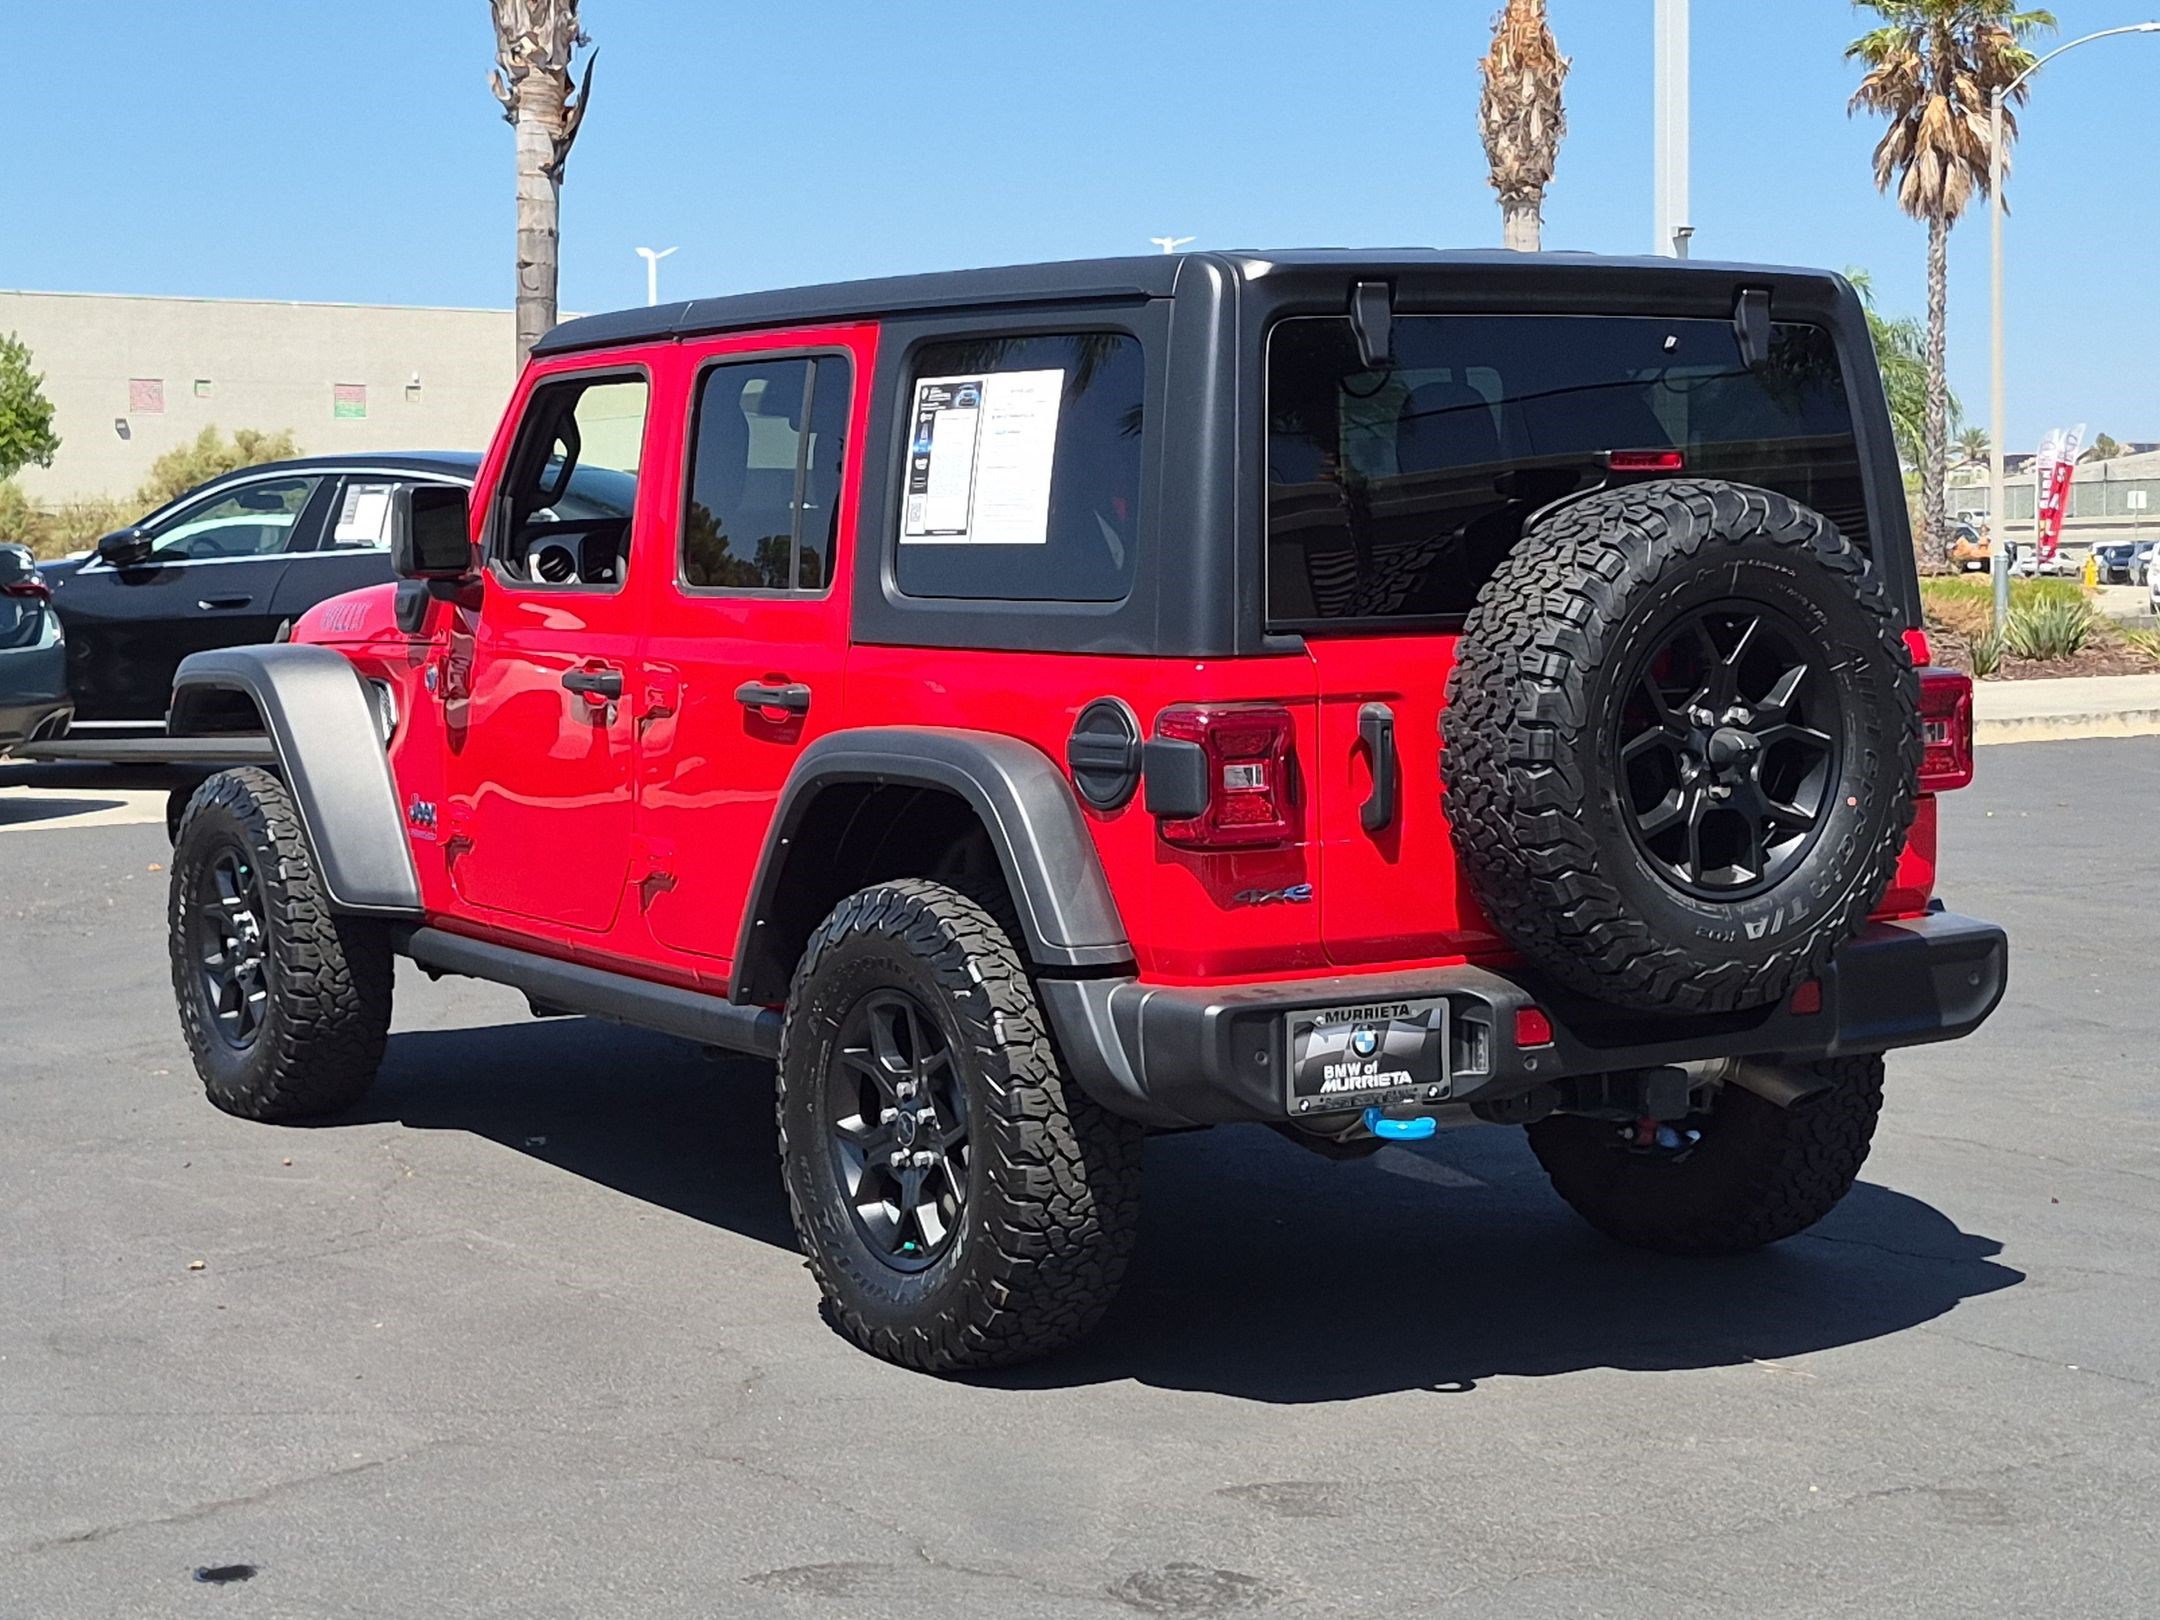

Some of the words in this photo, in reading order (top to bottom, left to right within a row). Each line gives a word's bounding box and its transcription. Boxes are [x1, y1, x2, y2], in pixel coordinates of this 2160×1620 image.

[1324, 1003, 1411, 1023] MURRIETA
[1323, 1062, 1361, 1080] BMW
[1363, 1060, 1378, 1076] of
[1320, 1071, 1412, 1093] MURRIETA
